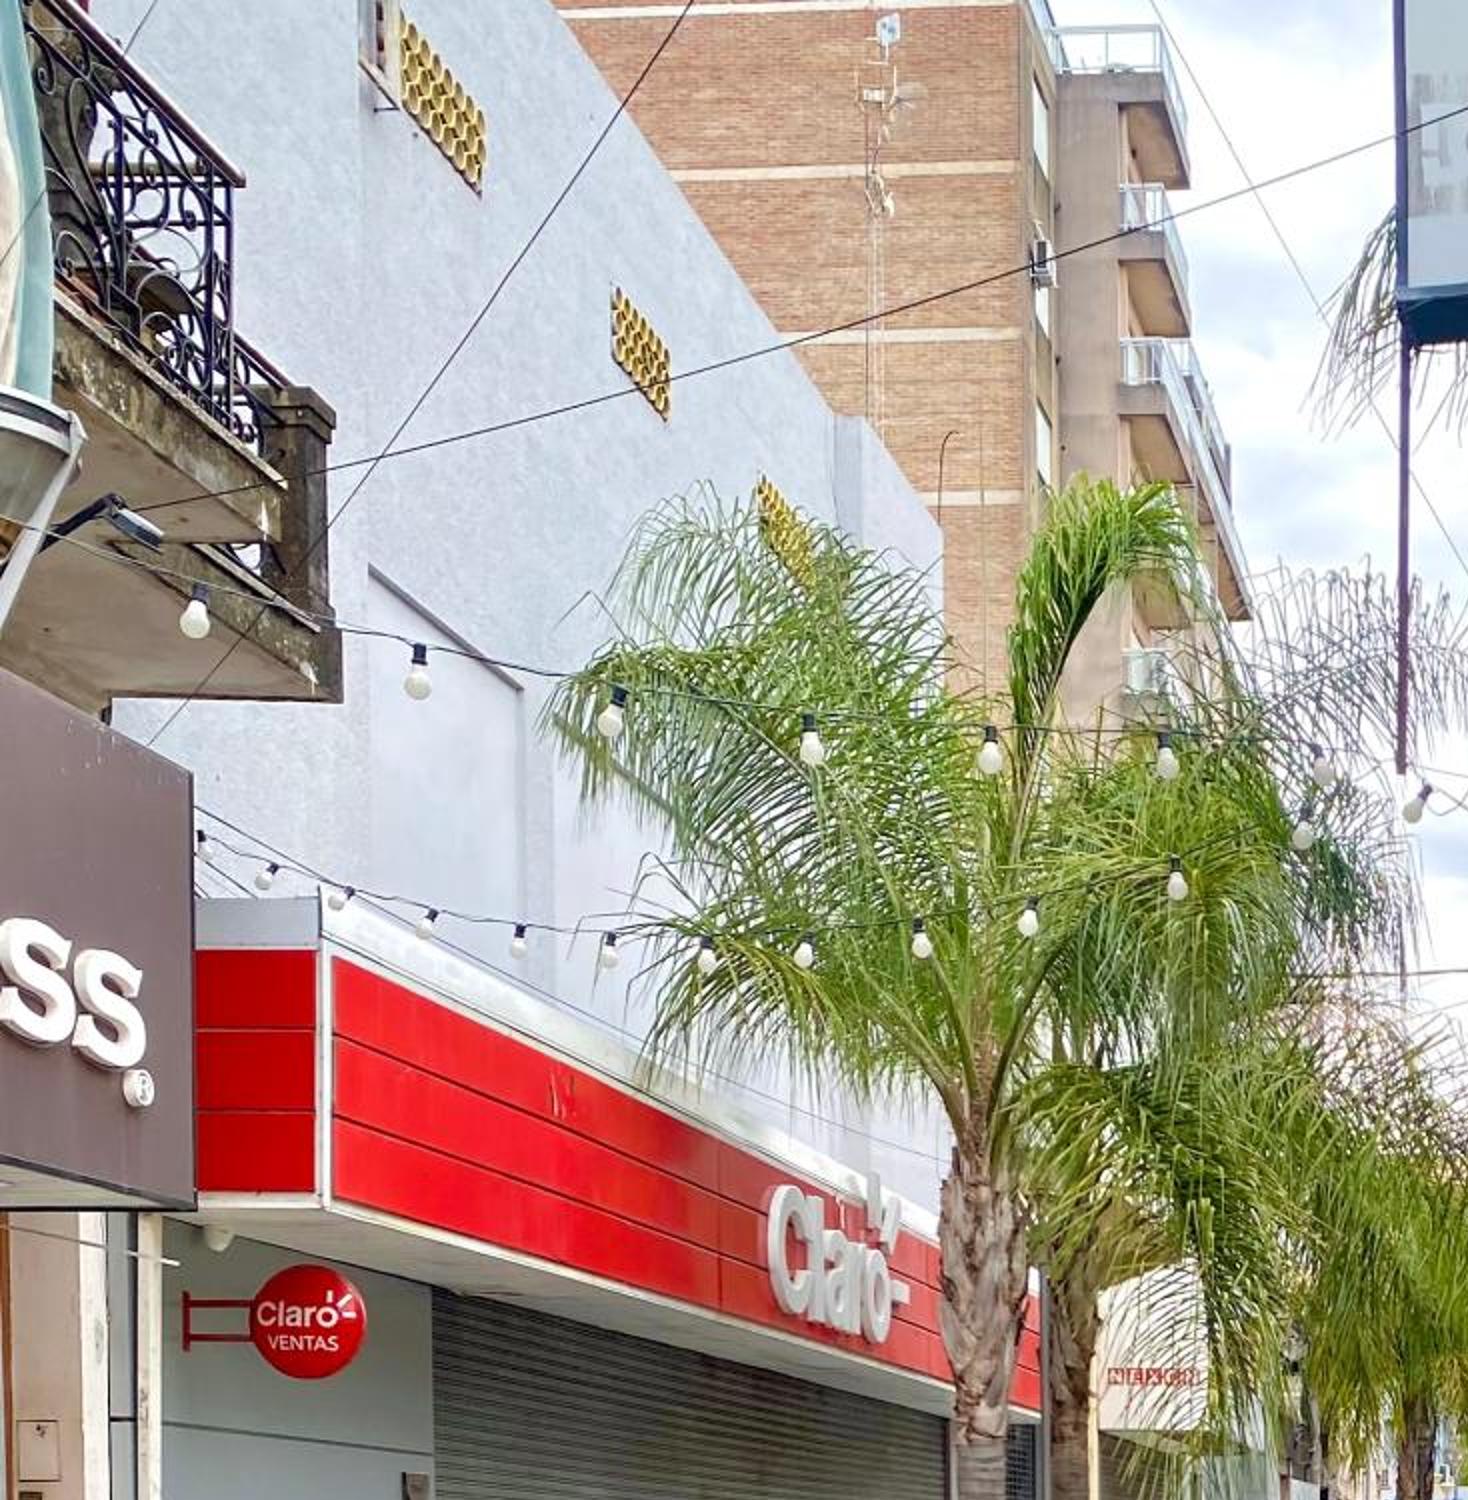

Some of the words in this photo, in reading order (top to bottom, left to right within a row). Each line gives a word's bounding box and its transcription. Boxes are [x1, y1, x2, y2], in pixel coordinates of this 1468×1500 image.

[768, 1182, 892, 1345] Claro
[257, 1300, 339, 1328] Claro
[267, 1334, 339, 1351] VENTAS
